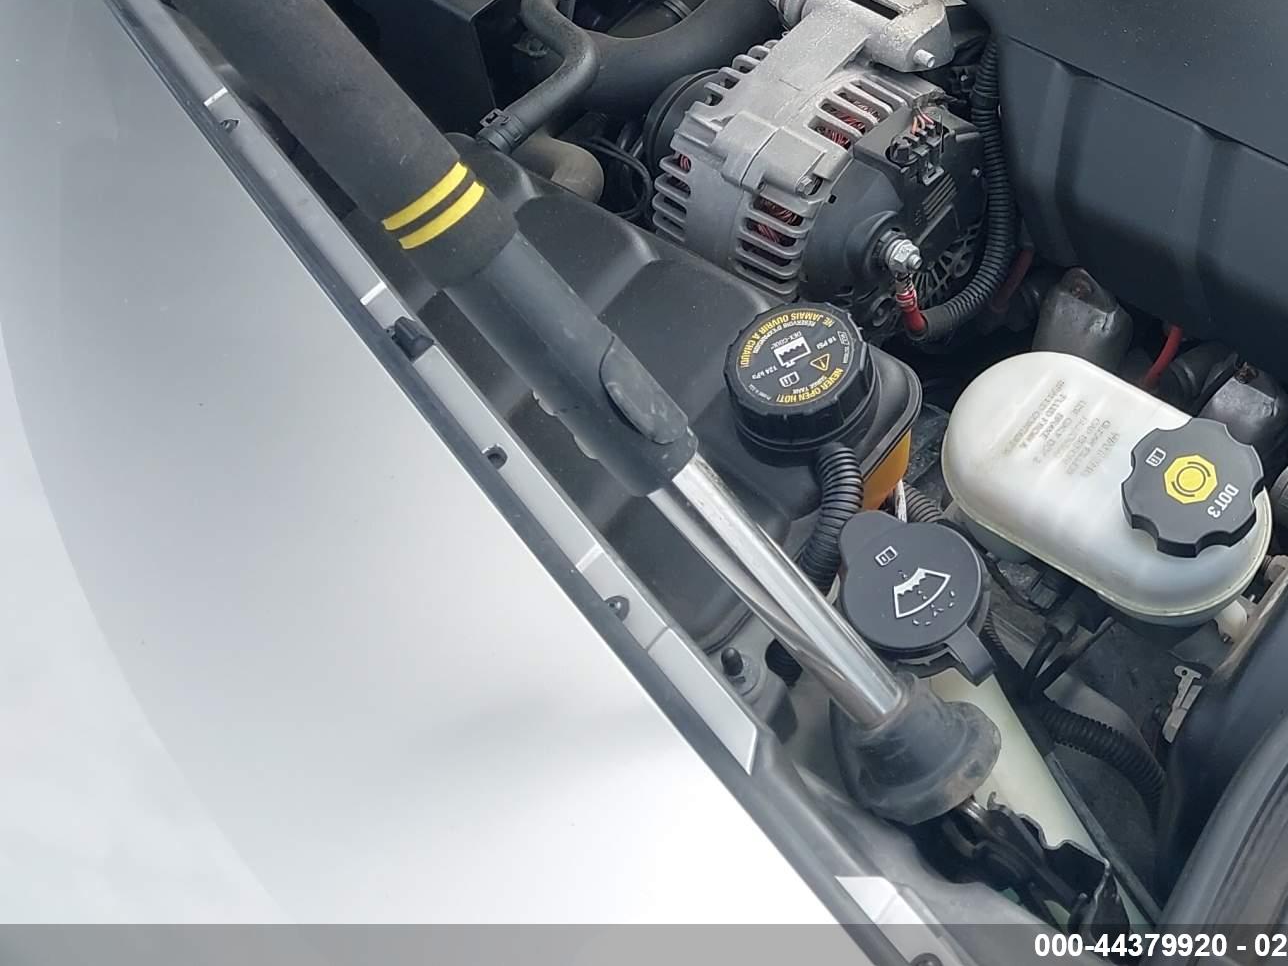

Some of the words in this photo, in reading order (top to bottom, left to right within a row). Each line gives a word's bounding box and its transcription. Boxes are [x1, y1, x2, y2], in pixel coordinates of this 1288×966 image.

[791, 312, 824, 322] JAMAIS
[823, 316, 835, 328] NE
[760, 315, 789, 335] OUVRIR
[816, 340, 828, 349] PSI
[825, 368, 844, 391] NEVER
[776, 394, 797, 403] HOT!
[799, 388, 821, 402] OPEN
[1214, 483, 1239, 511] DOT
[1207, 505, 1221, 518] 3
